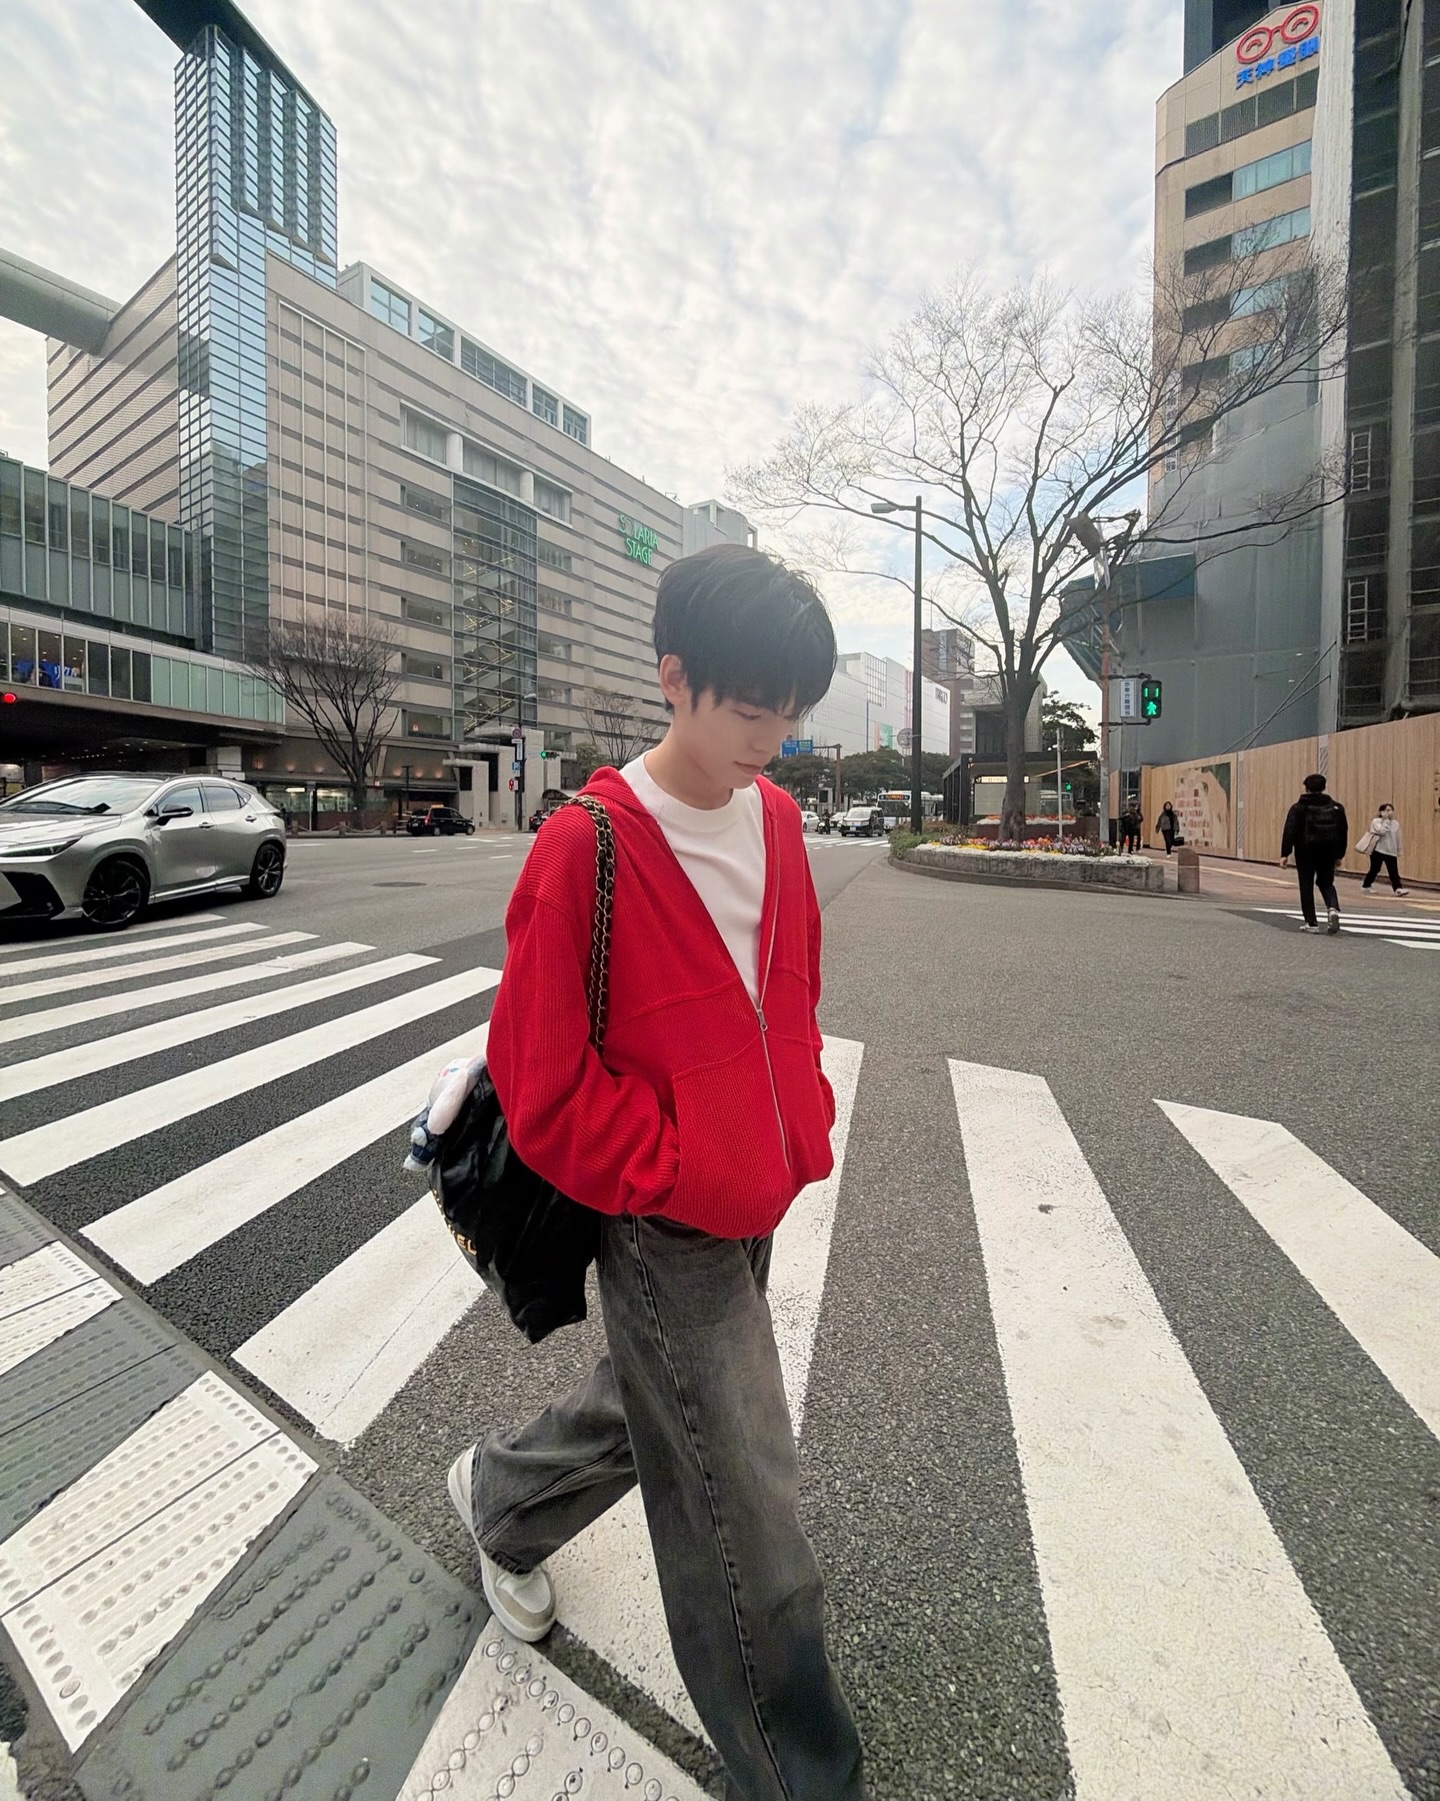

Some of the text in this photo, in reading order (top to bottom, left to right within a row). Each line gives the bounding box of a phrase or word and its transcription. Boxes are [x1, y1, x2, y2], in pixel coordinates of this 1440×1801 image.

[1236, 36, 1320, 89] 天神愛眼
[619, 514, 659, 549] SOLARIA
[625, 537, 653, 566] STAGE
